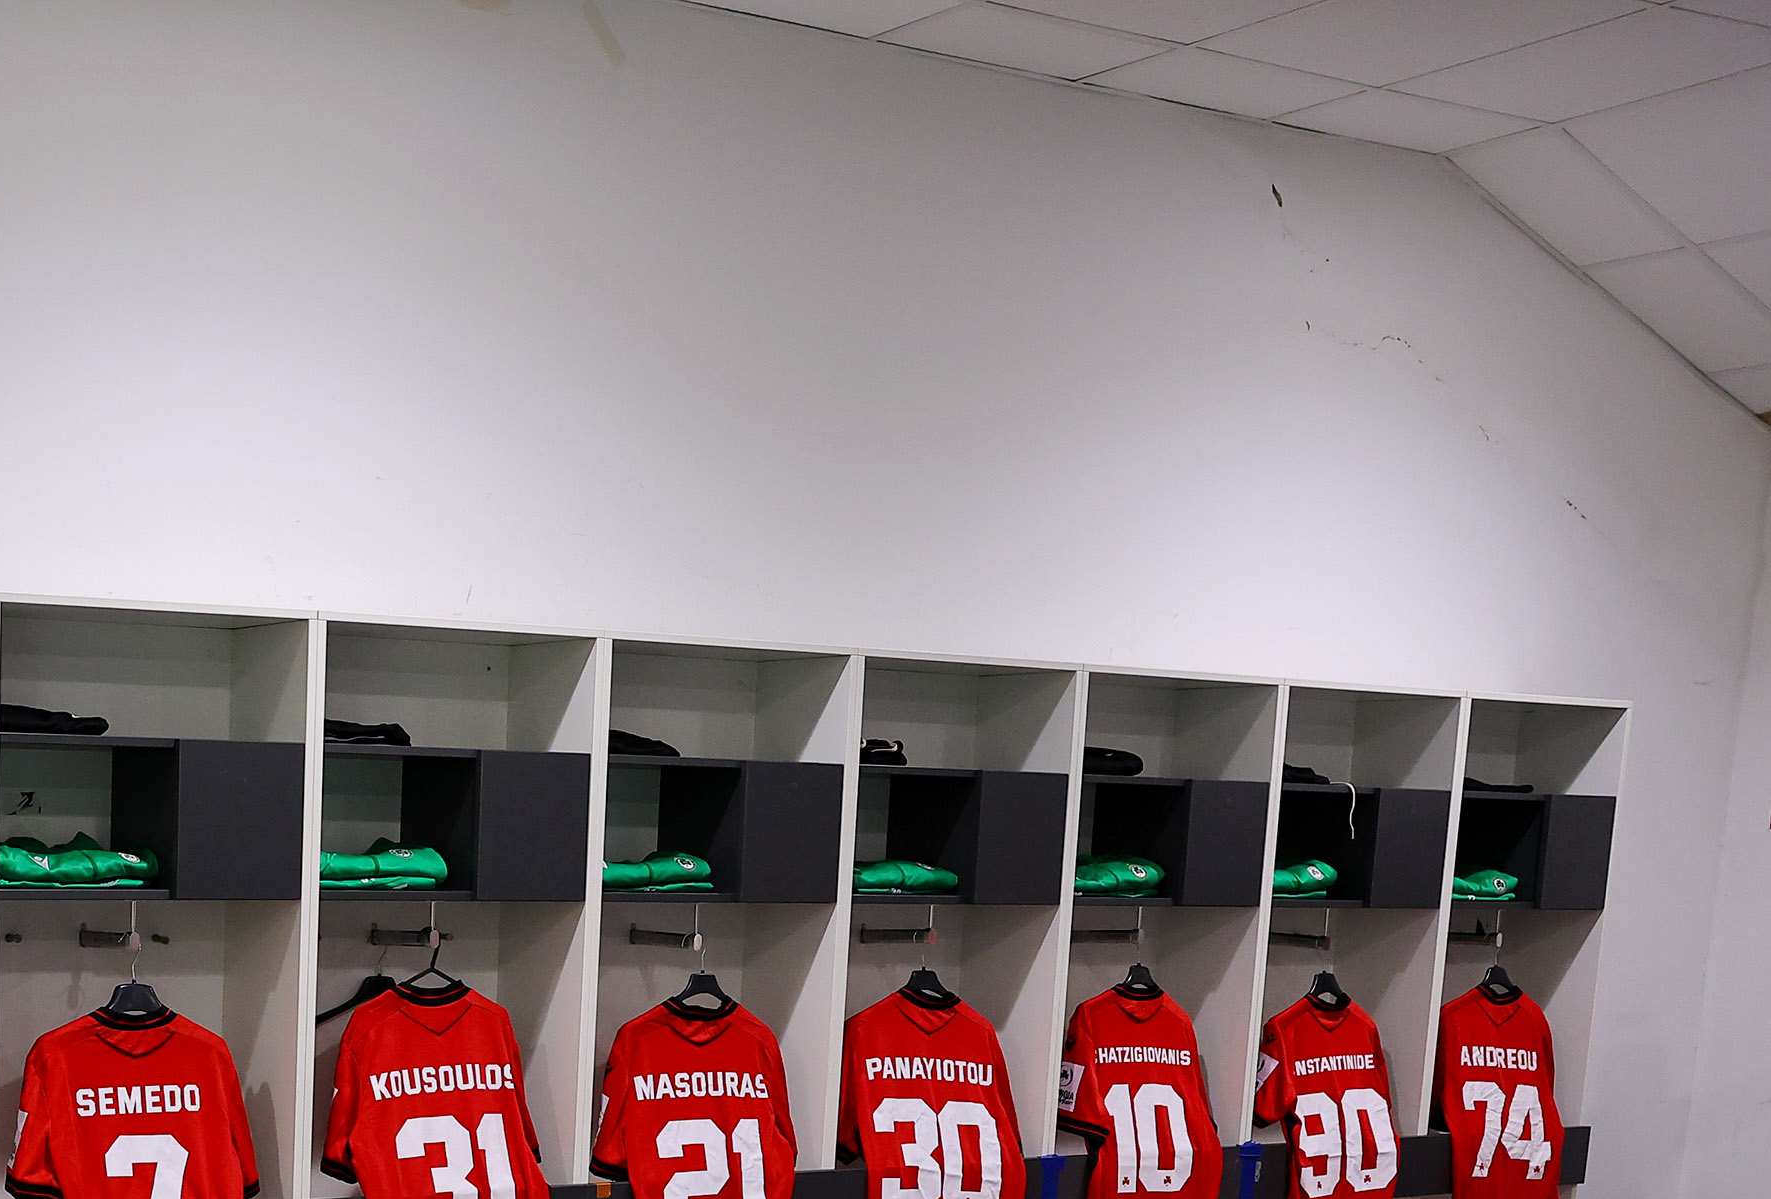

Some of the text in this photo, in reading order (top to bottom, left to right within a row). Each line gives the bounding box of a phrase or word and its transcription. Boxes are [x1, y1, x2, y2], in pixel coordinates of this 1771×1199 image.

[1095, 1047, 1191, 1066] HATZIGIOVANIS
[1294, 1054, 1374, 1076] NSTANTINIDE
[1461, 1046, 1537, 1071] ANDREOU
[634, 1072, 768, 1100] MASOURAS
[866, 1057, 992, 1086] PANAYIOTOU
[76, 1085, 200, 1116] SEMEDO
[1104, 1084, 1193, 1193] 10
[1298, 1088, 1398, 1198] 90
[1463, 1082, 1551, 1179] 74
